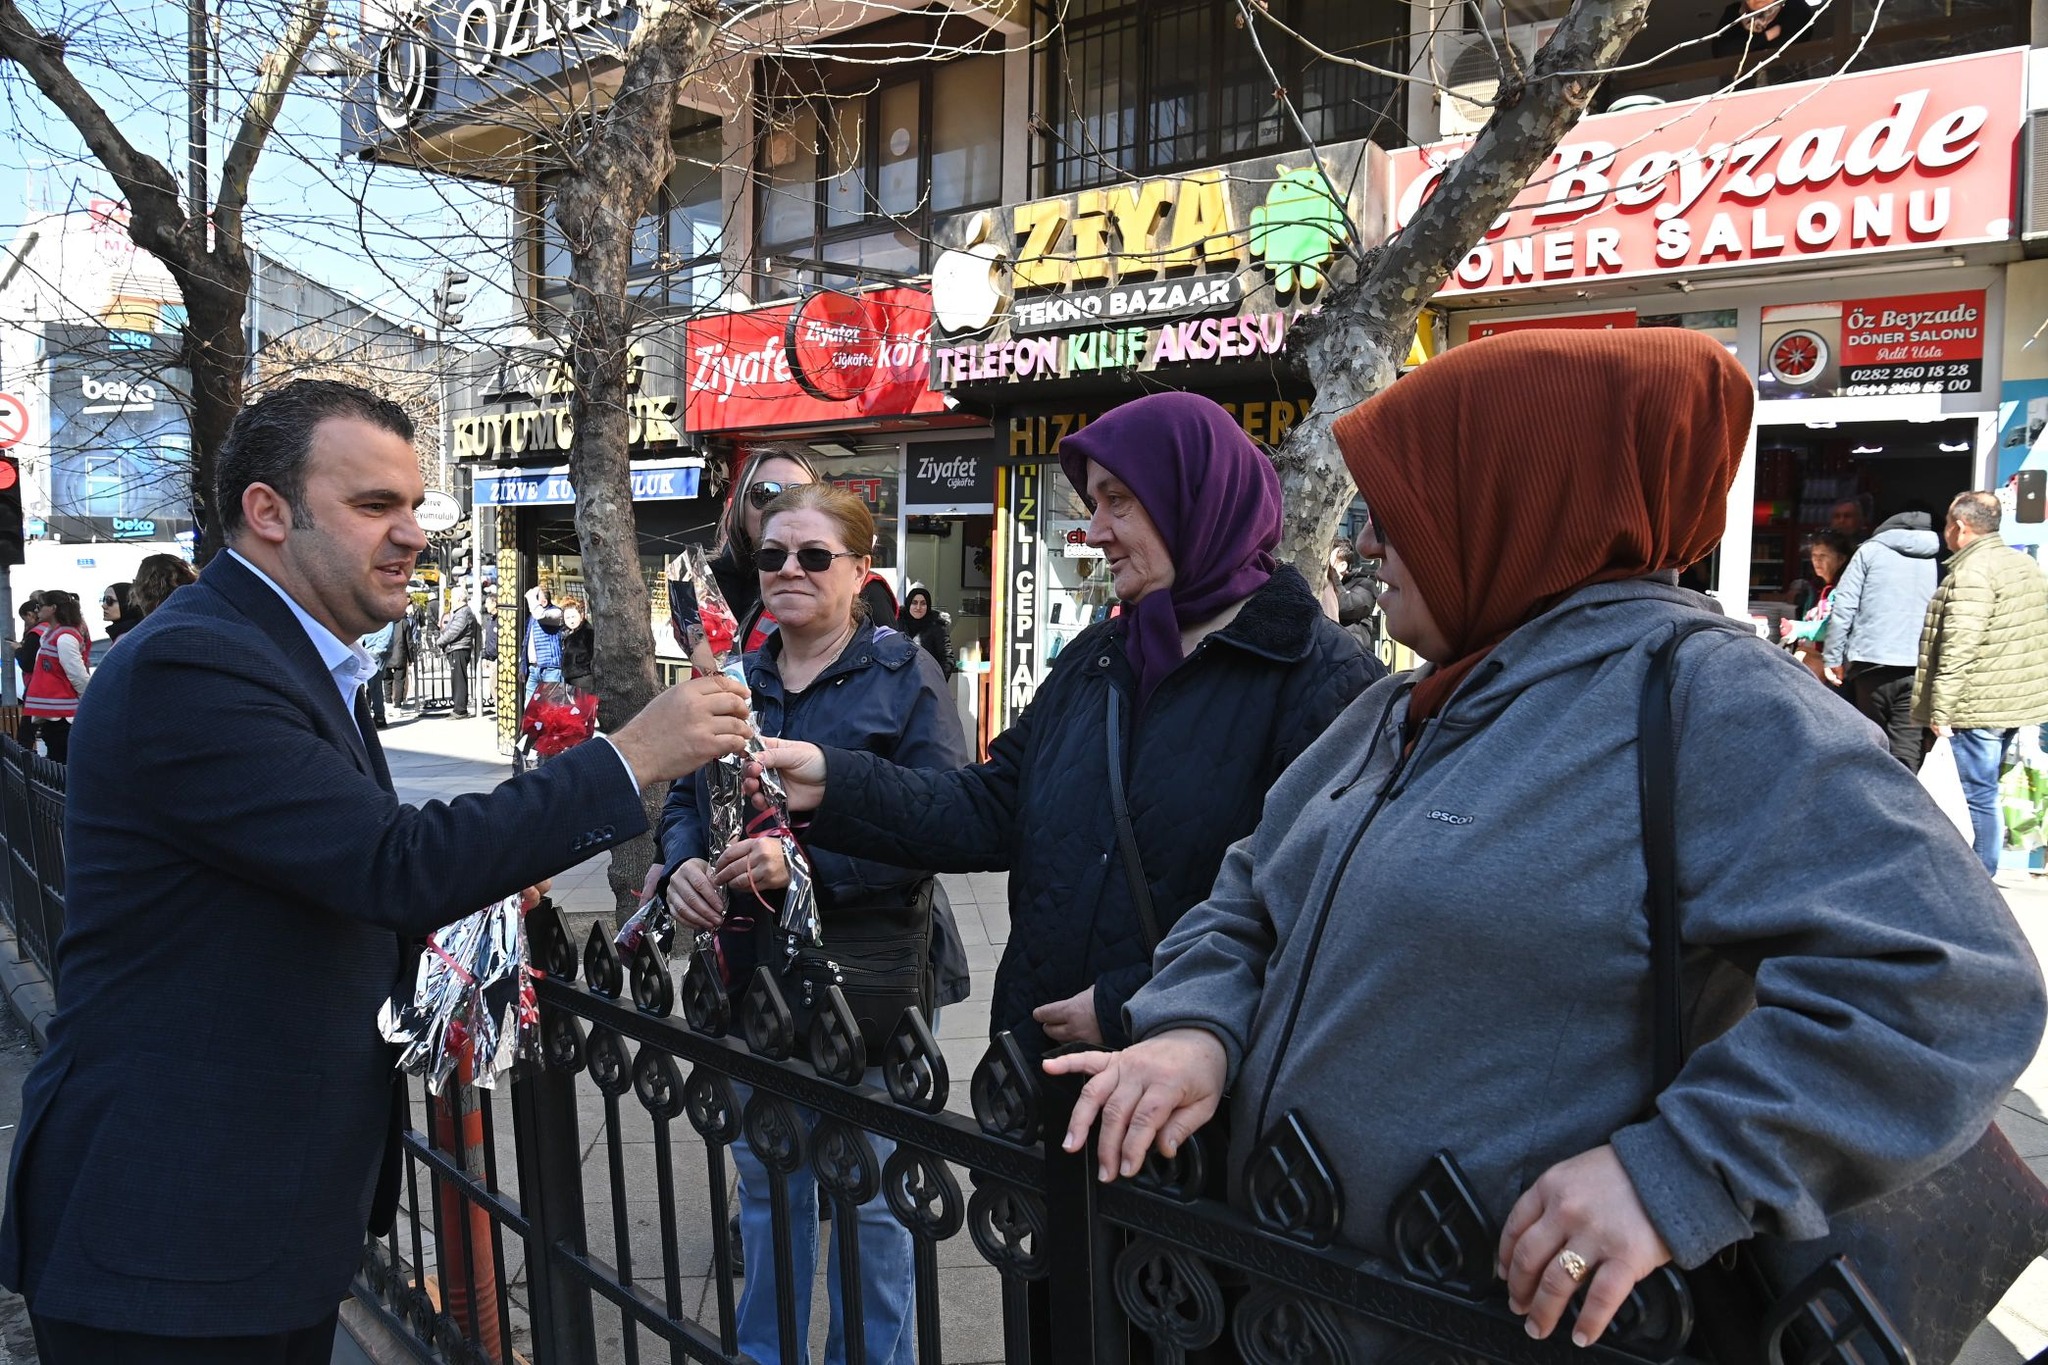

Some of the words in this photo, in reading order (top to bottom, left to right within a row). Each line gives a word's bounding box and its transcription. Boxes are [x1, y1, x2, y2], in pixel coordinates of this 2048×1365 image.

[1532, 88, 1989, 221] Beyzade
[1457, 226, 1623, 282] ÖNER
[1656, 186, 1951, 260] SALONU
[1015, 297, 1102, 327] TEKNO
[1109, 280, 1231, 316] BAZAAR
[1848, 307, 1876, 329] Öz
[1880, 303, 1978, 330] Beyzade
[109, 331, 152, 346] beko
[805, 321, 861, 347] Ziyafet
[937, 337, 1058, 382] TELEFON
[1068, 327, 1147, 371] KILIF
[1152, 308, 1304, 363] AKSESU
[1849, 331, 1905, 346] DÖNER
[1909, 328, 1978, 342] SALONU
[1876, 345, 1910, 361] Adil
[1911, 345, 1944, 359] Usta
[690, 336, 792, 403] Ziyafe
[1850, 368, 1890, 381] 0282
[1893, 366, 1925, 380] 260
[1927, 365, 1945, 377] 18
[1946, 363, 1970, 377] 28
[82, 375, 157, 403] beko
[1947, 379, 1972, 391] 00
[453, 396, 679, 457] KUYUMCUK
[917, 455, 978, 485] Ziyafet
[490, 478, 538, 502] ZİRVE
[112, 518, 155, 532] beko
[1016, 570, 1034, 638] CEP
[1011, 642, 1034, 717] TAM
